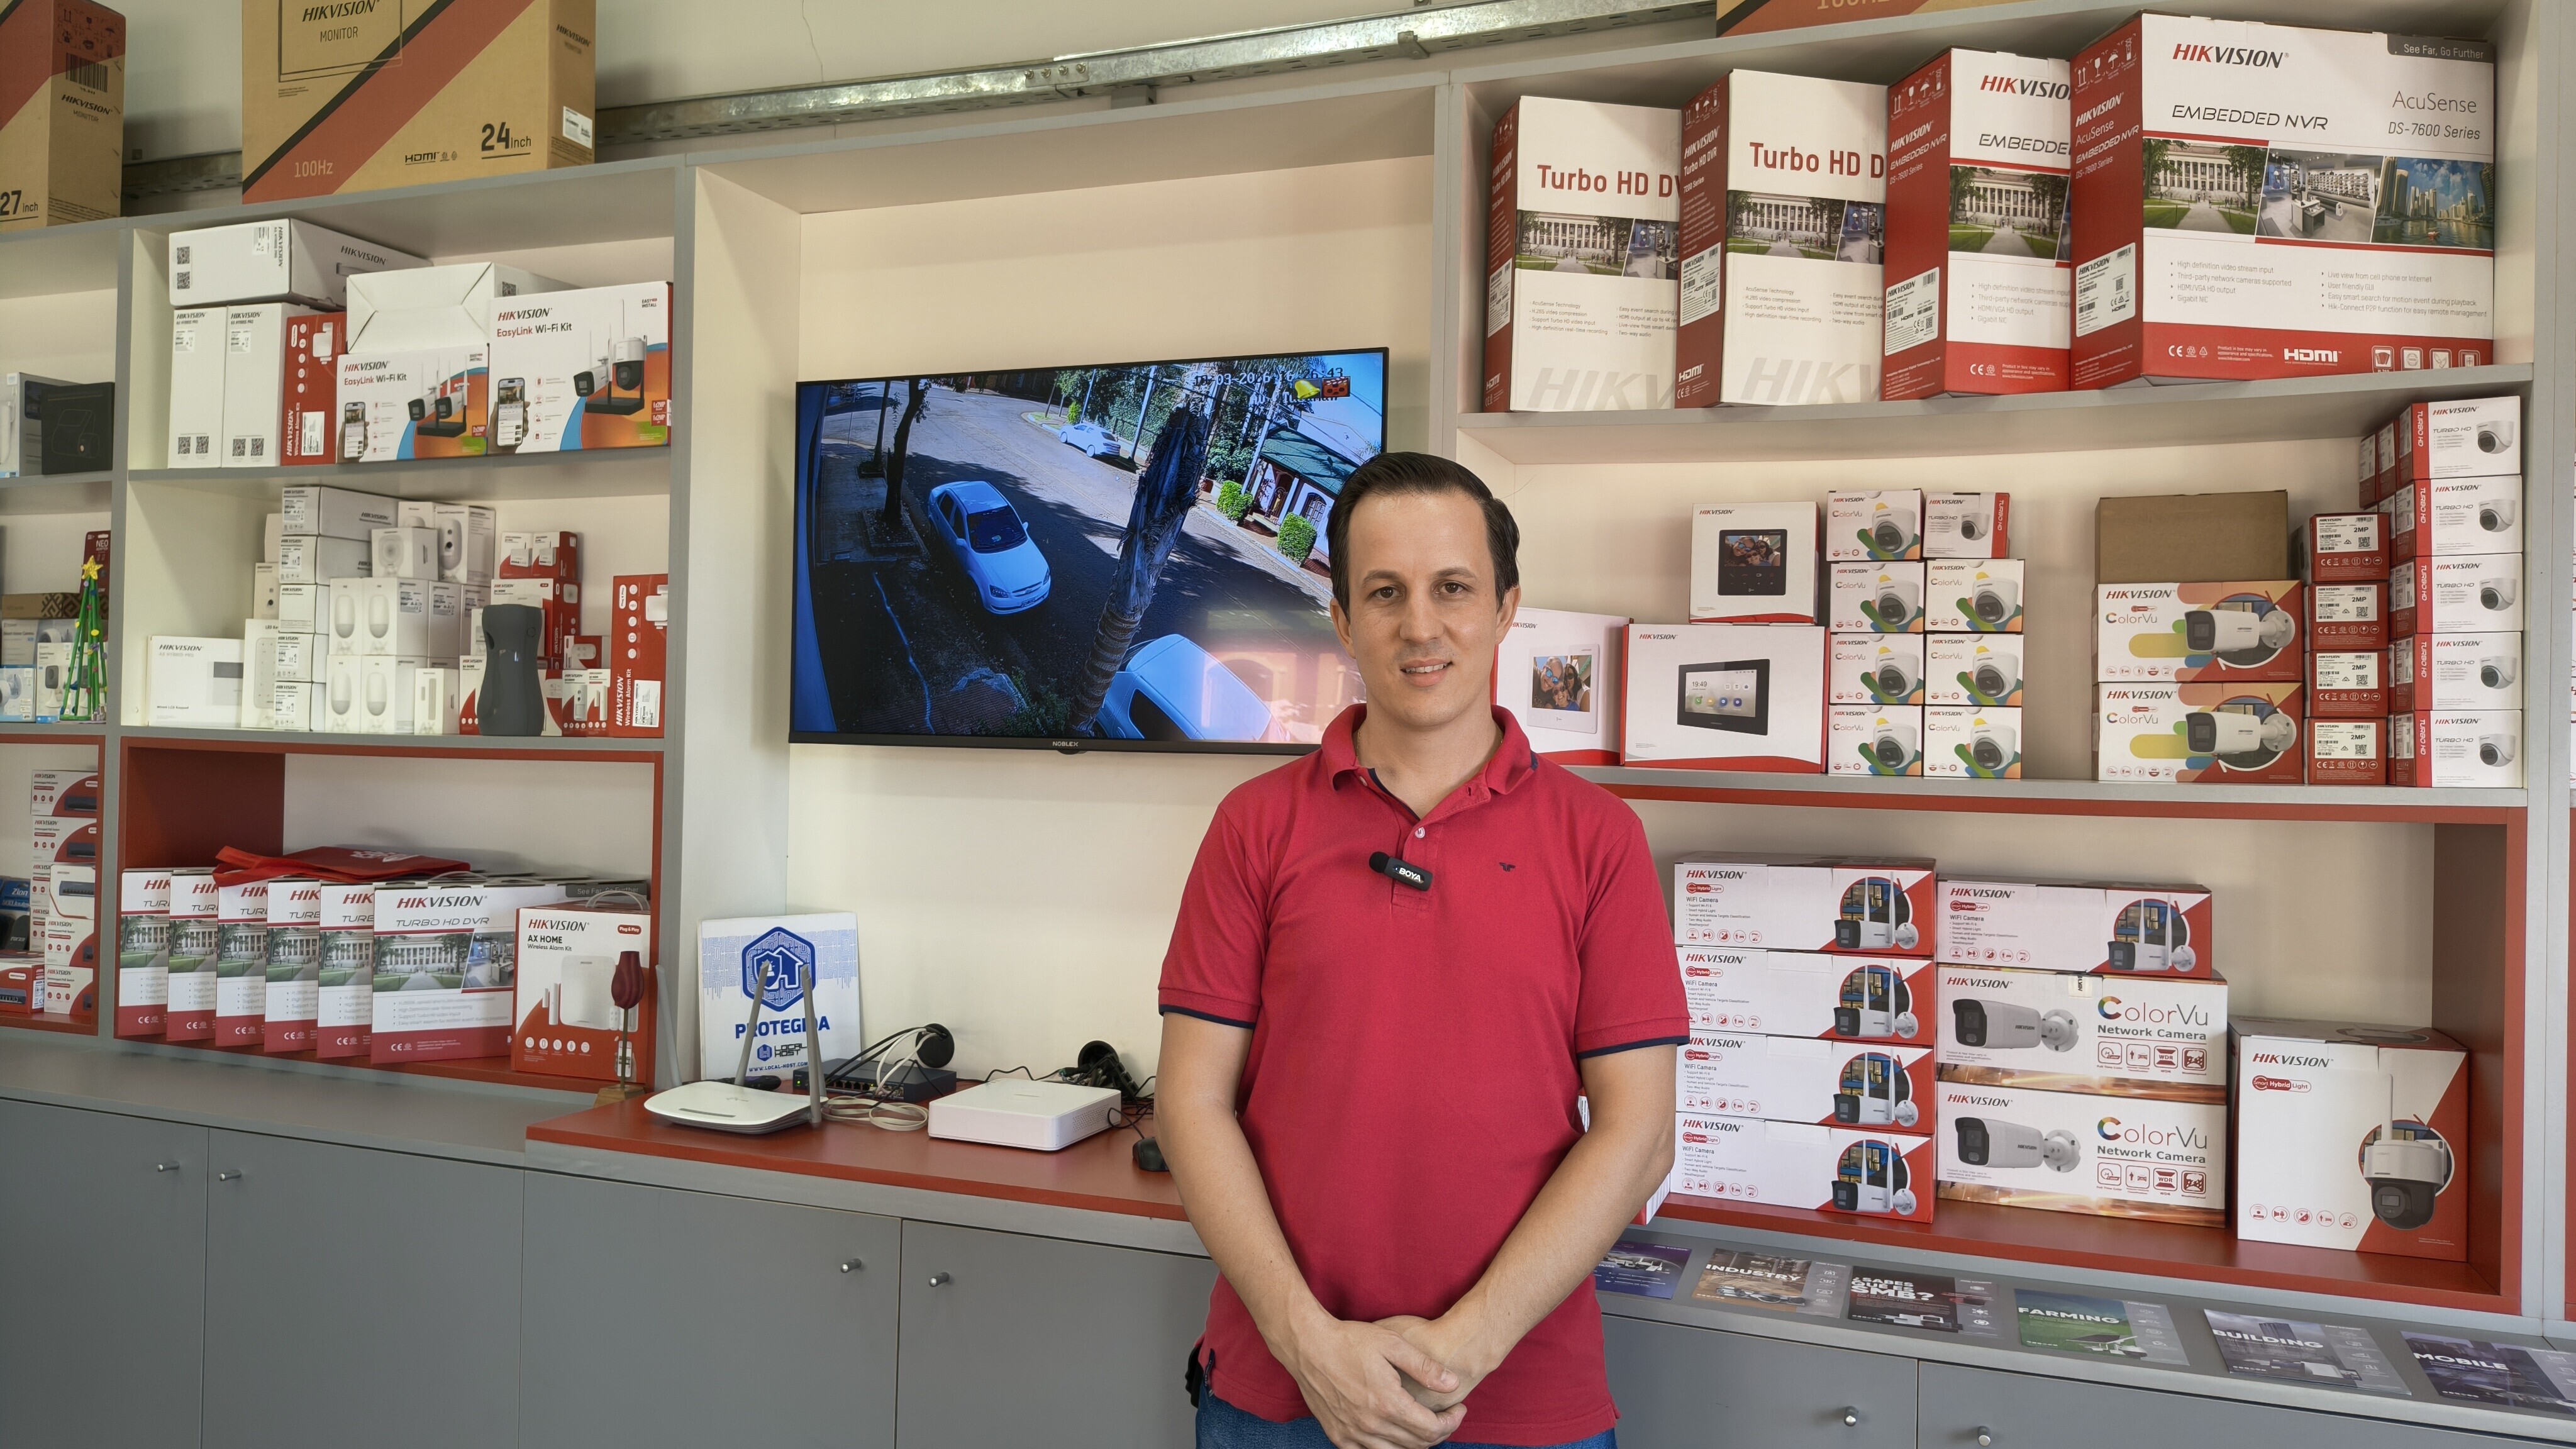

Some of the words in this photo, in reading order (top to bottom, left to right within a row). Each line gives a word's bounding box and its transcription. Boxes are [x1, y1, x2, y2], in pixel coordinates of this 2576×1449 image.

[302, 0, 375, 22] HIKVISION
[320, 26, 358, 42] MONITOR
[557, 24, 591, 47] HIKVISION
[2172, 43, 2285, 69] HIKVISION
[2404, 43, 2419, 54] See
[2422, 44, 2438, 56] Far,
[2440, 47, 2451, 57] Go
[2453, 47, 2484, 59] Further
[1980, 75, 2071, 100] HIKVISIO
[62, 94, 111, 115] HIKVISION
[2392, 90, 2477, 114] AcuSense
[2075, 94, 2121, 127] HIKVISION
[2172, 104, 2280, 126] EMBEDDED
[2285, 114, 2328, 131] NVR
[481, 122, 509, 152] 24
[1890, 121, 1933, 152] HIKVISION
[2075, 120, 2114, 147] AcuSense
[2388, 121, 2441, 138] DS-7600
[2443, 126, 2481, 141] Series
[1684, 127, 1719, 159] HIKVISION
[1979, 134, 2071, 155] EMBEDDE
[2076, 135, 2120, 164] EMBEDDED
[2121, 125, 2140, 142] NVR
[1750, 142, 1819, 172] Turbo
[1829, 150, 1860, 177] HD
[1890, 143, 1929, 170] EMBEDDED
[1930, 134, 1947, 149] NVR
[294, 160, 333, 178] 100Hz
[1684, 162, 1698, 177] Turbo
[1699, 154, 1706, 167] HD
[1707, 147, 1717, 161] DVR
[1536, 165, 1607, 193] Turbo
[1618, 170, 1648, 196] HD
[0, 190, 22, 216] 27
[341, 245, 387, 266] HIKVISION
[2178, 272, 2210, 282] Third-party
[498, 308, 550, 321] HIKVISION
[497, 326, 533, 338] EasyLink
[535, 325, 558, 334] Wi-Fi
[560, 323, 572, 332] Kit
[2284, 348, 2338, 363] HDMI
[345, 361, 389, 372] HIKVISION
[344, 375, 374, 386] EasyLink
[377, 374, 395, 383] Wi-Fi
[397, 373, 407, 382] Kit
[2433, 406, 2477, 416] HIKVISION
[2418, 436, 2423, 447] HD
[2435, 484, 2479, 492] HIKVISION
[1931, 578, 1962, 586] ColorVu
[2106, 590, 2173, 599] HIKVISION
[2106, 612, 2157, 625] ColorVu
[2107, 691, 2174, 700] HIKVISION
[2107, 713, 2158, 724] ColorVu
[1399, 867, 1421, 882] BOYA
[1686, 870, 1745, 879] HIKVISION
[1950, 887, 2012, 899] HIKVISION
[397, 896, 485, 909] HIKVISION
[396, 919, 440, 928] TURBO
[443, 918, 460, 926] HD
[464, 917, 489, 926] DVR
[528, 919, 586, 932] HIKVISION
[528, 935, 537, 943] AX
[540, 935, 563, 944] HOME
[1685, 953, 1743, 963] HIKVISION
[1946, 977, 2010, 989] HIKVISION
[2097, 996, 2208, 1026] ColorVu
[735, 1016, 830, 1039] POTEGIA
[2097, 1024, 2152, 1037] Network
[2157, 1029, 2207, 1040] Camera
[2252, 1053, 2330, 1068] HIKVISION
[2270, 1080, 2290, 1089] Hybrid
[2292, 1082, 2308, 1091] Light
[1947, 1093, 2010, 1108] HIKVISION
[1682, 1119, 1741, 1133] HIKVISION
[2097, 1116, 2207, 1150] ColorVu
[2097, 1145, 2151, 1158] Network
[2156, 1151, 2206, 1163] Camera
[1706, 1263, 1802, 1283] INDUSTRY
[1851, 1285, 1934, 1301] SMB?
[2018, 1307, 2120, 1324] FARMING
[2212, 1328, 2324, 1350] BUILDING
[2413, 1352, 2509, 1372] MOBILE
